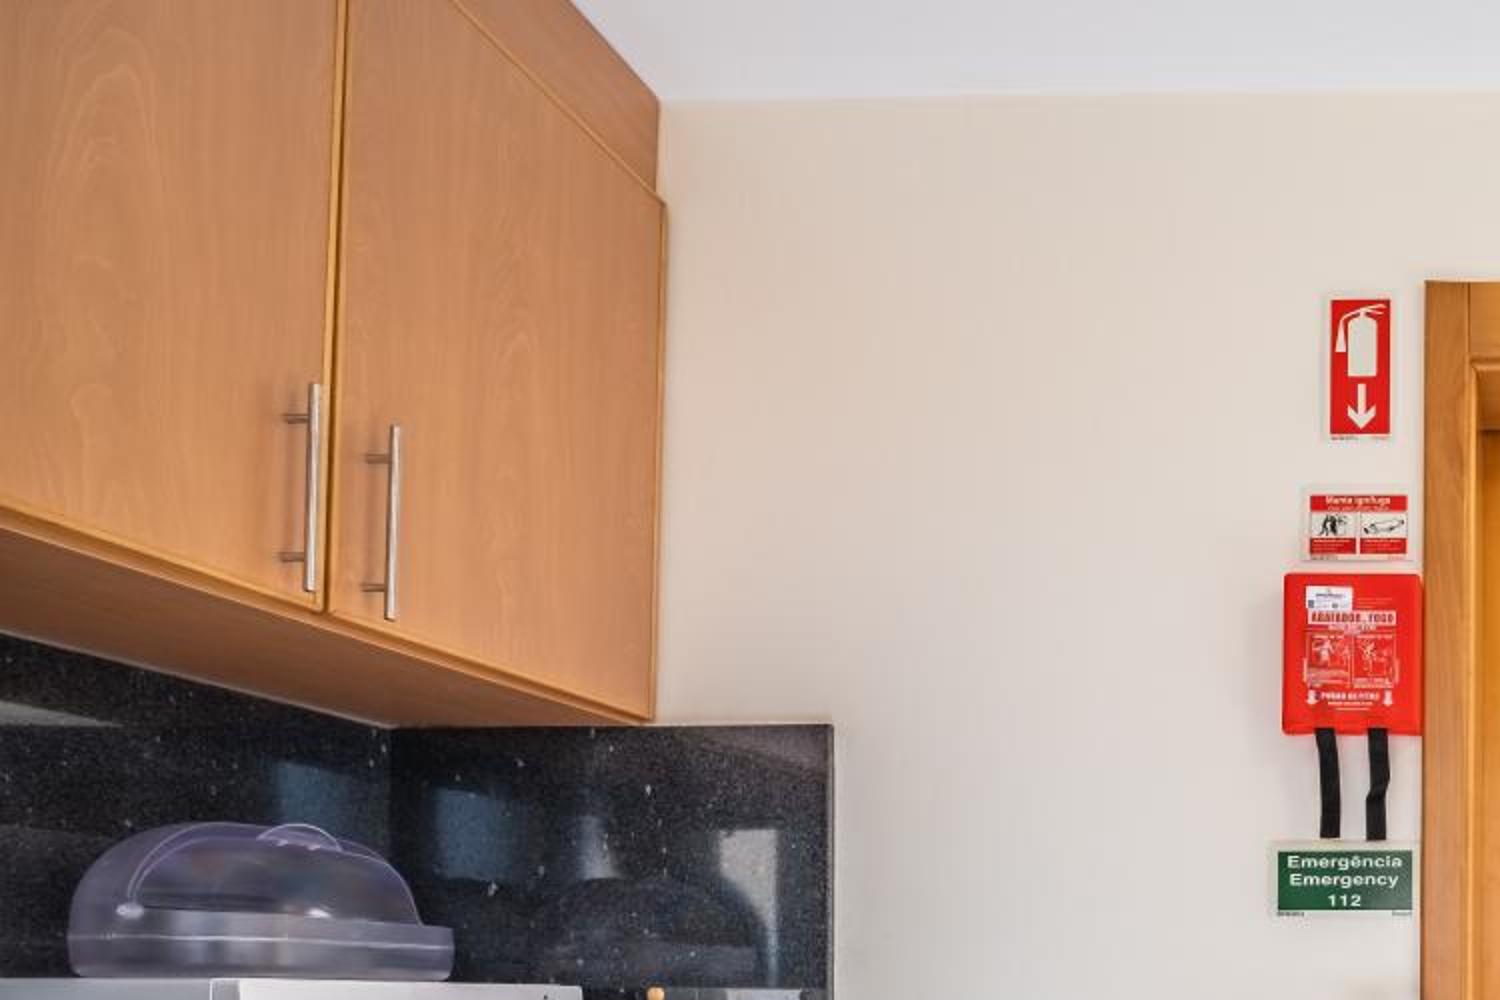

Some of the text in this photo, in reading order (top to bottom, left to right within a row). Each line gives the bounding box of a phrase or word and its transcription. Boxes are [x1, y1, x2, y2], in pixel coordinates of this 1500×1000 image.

[1287, 855, 1403, 870] Emergência
[1289, 873, 1399, 888] Emergency
[1328, 894, 1361, 907] 112
